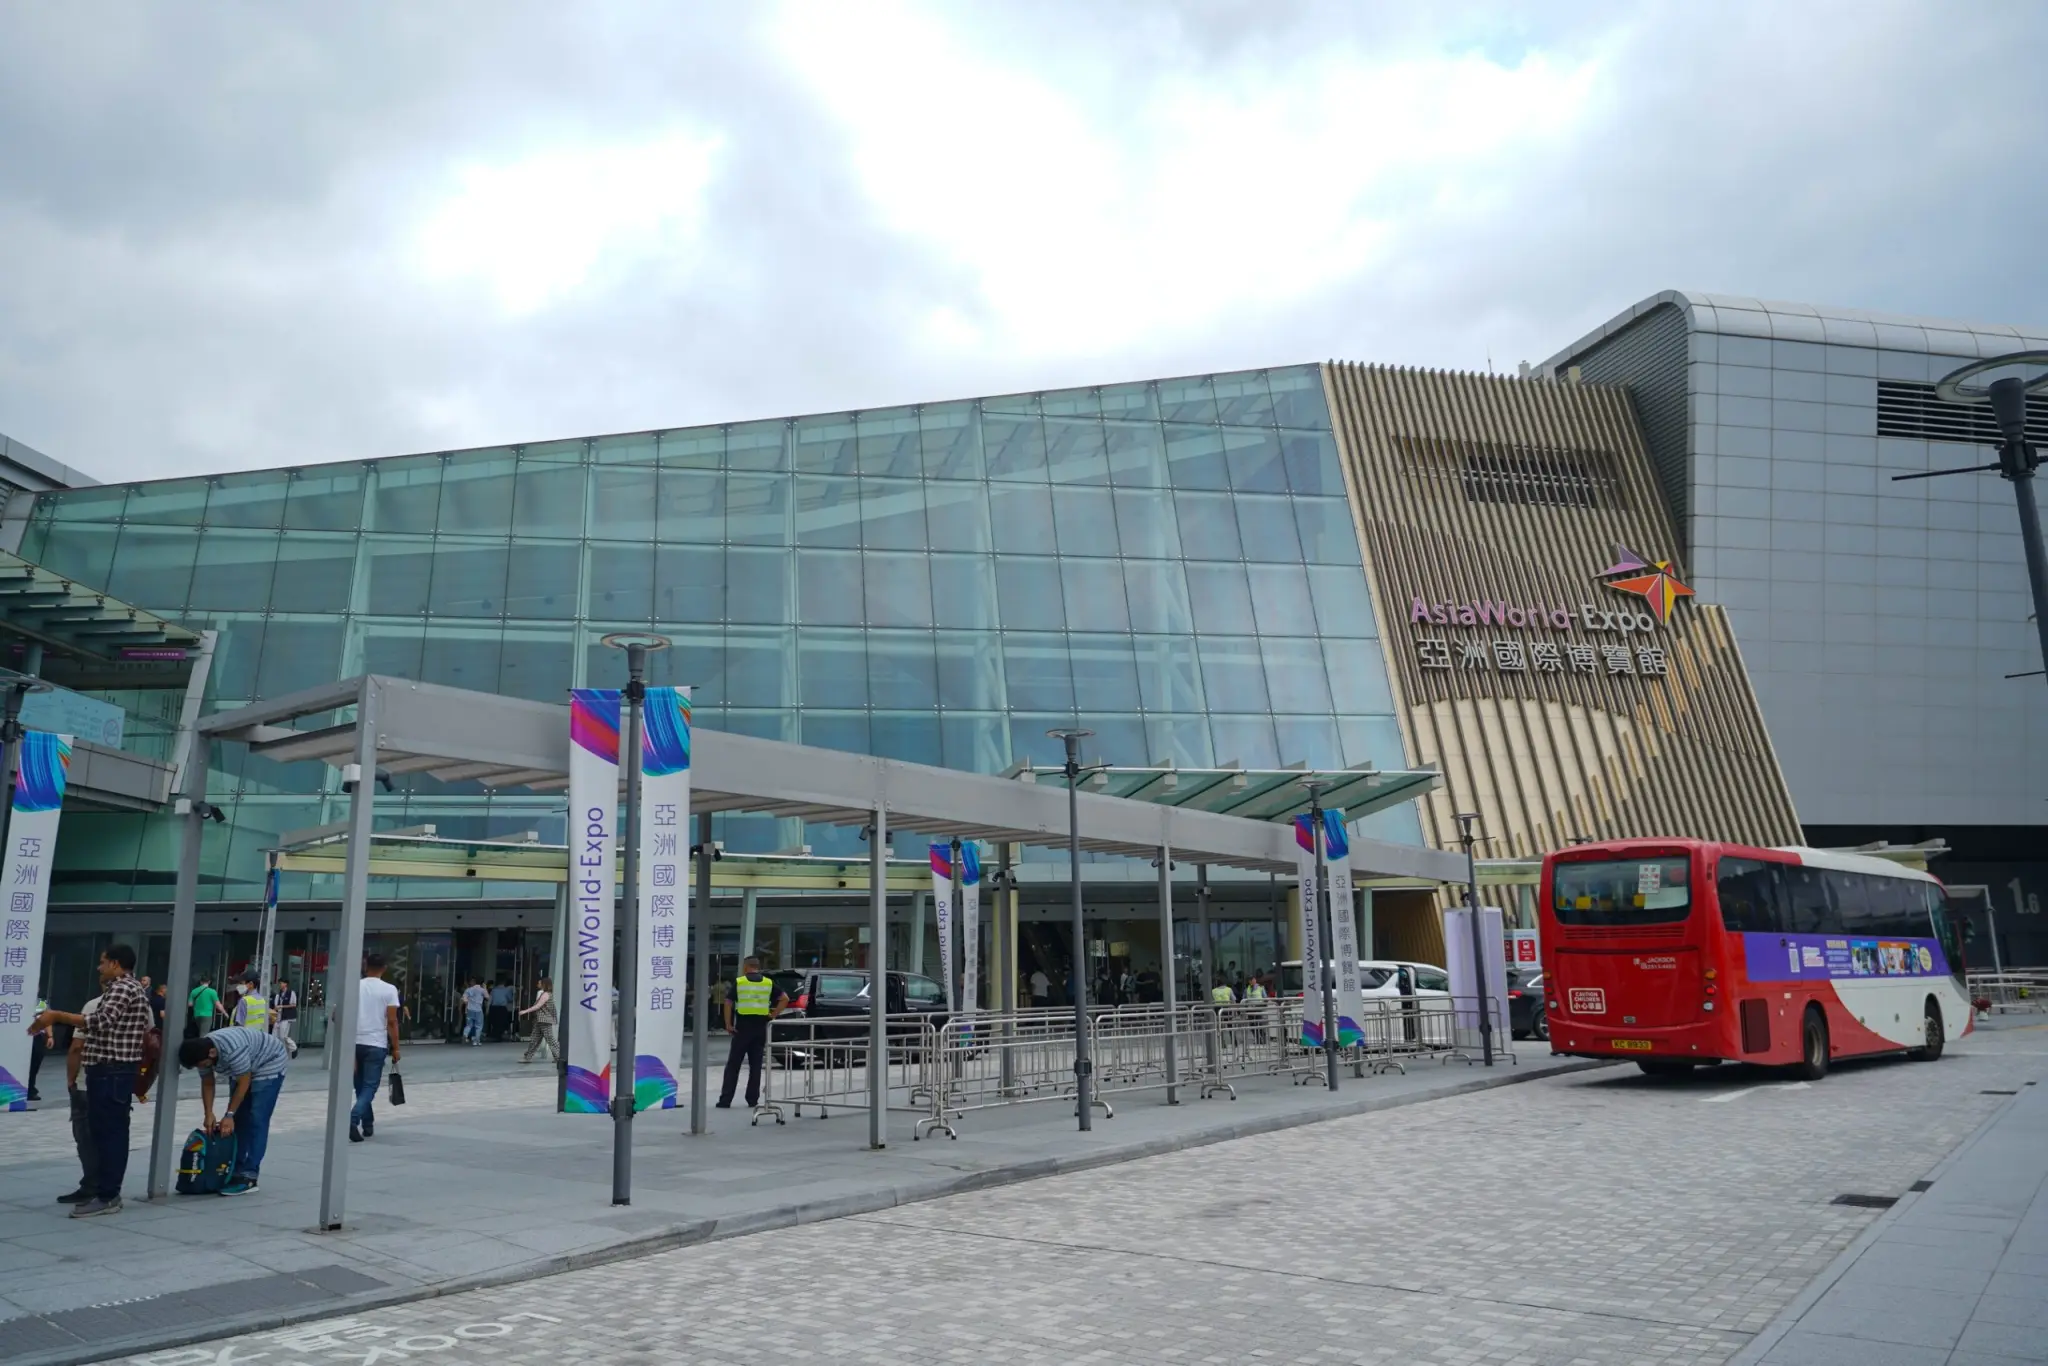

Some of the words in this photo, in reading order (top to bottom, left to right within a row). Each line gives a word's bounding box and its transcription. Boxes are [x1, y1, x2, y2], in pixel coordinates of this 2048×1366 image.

[1411, 596, 1655, 637] AsiaWorld-Expo
[1416, 638, 1669, 676] 亞洲國際博覽館
[0, 837, 41, 1025] 亞洲國際博覽館
[579, 806, 609, 1013] AsiaWorld-Expo
[650, 803, 677, 1011] 亞洲國際博覽館
[1303, 878, 1317, 992] AsiaWorld-Expo
[2007, 877, 2040, 914] 1.6
